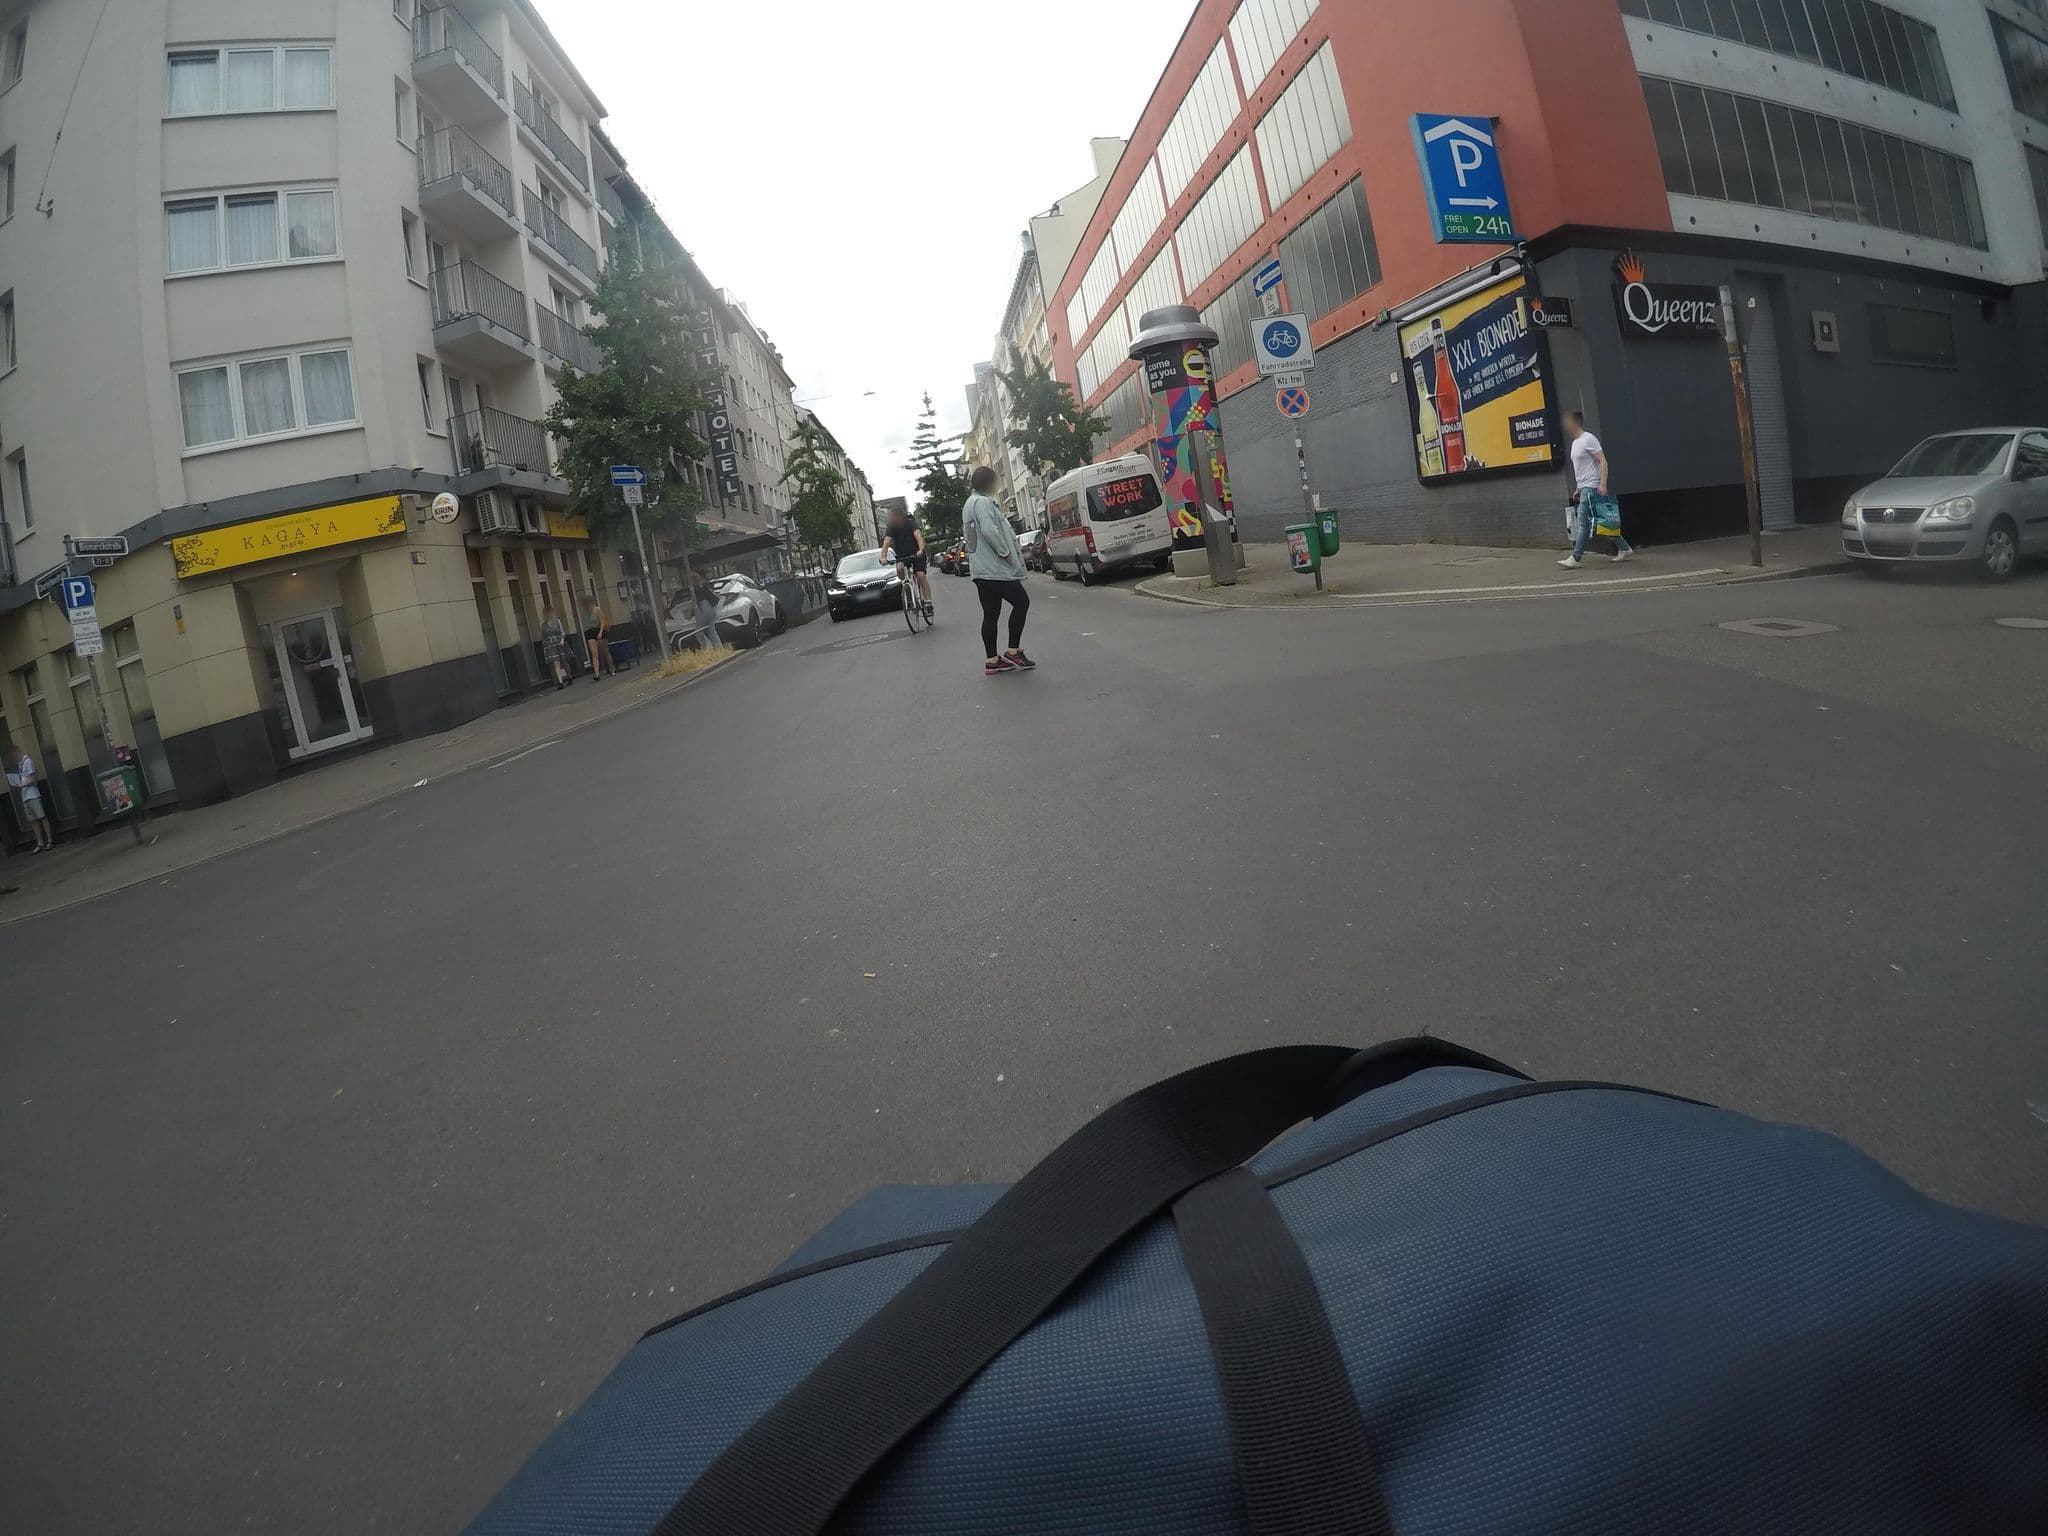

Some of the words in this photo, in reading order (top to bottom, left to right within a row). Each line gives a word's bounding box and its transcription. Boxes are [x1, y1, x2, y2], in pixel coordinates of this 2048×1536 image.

[1449, 139, 1482, 187] P
[1444, 214, 1462, 223] FREI
[1473, 216, 1511, 235] 24h
[1447, 225, 1469, 234] OPEN
[1624, 282, 1716, 333] Queenz
[1532, 309, 1568, 326] Queenz
[1452, 339, 1477, 373] XXL
[1148, 360, 1170, 372] come
[1150, 371, 1159, 380] as
[1159, 368, 1177, 380] you
[1261, 359, 1311, 372] Fahrradstraße
[1151, 380, 1163, 389] are
[1277, 375, 1289, 386] Kfz
[1290, 374, 1302, 384] frei
[1515, 417, 1545, 432] BIONADE
[1097, 478, 1144, 497] STREET
[1103, 490, 1144, 507] WORK
[242, 520, 338, 550] KAGAYA
[70, 581, 86, 607] P
